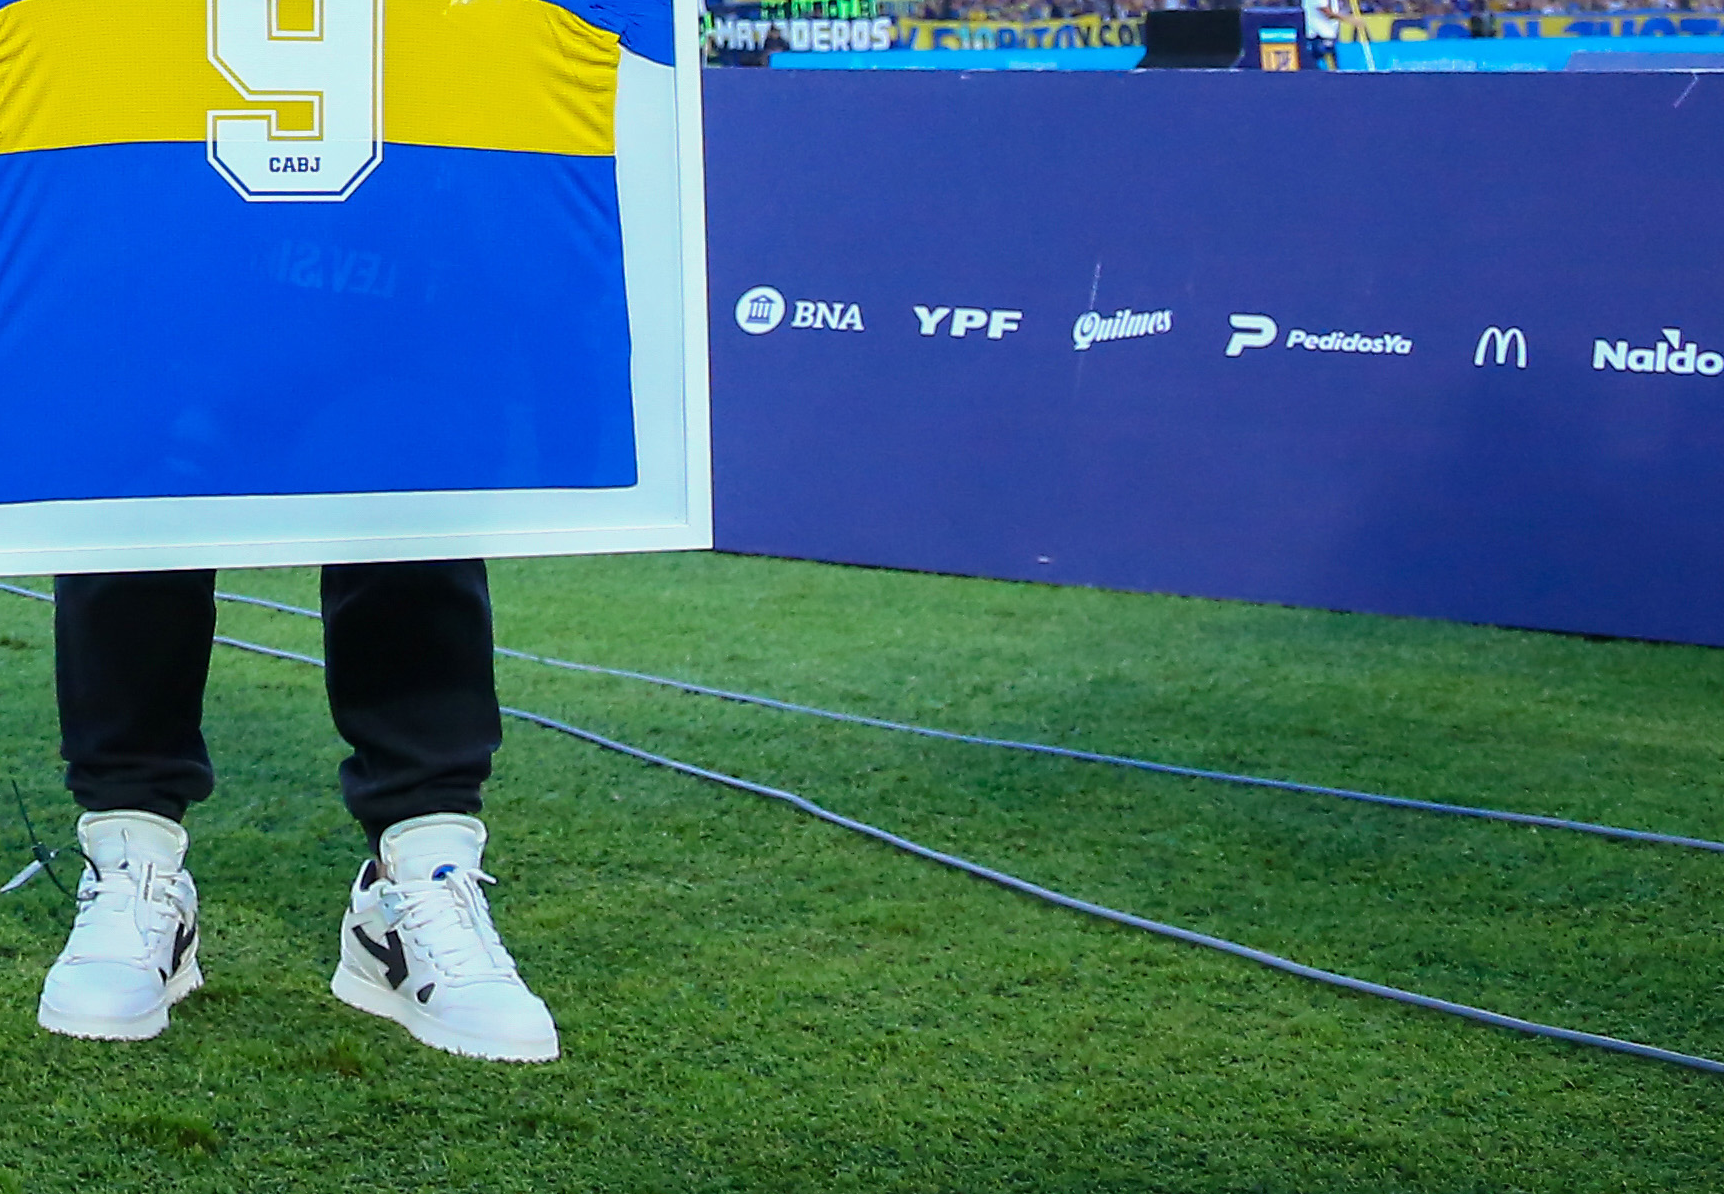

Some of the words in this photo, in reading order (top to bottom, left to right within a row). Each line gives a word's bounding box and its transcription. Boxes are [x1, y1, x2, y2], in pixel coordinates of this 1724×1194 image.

[269, 156, 321, 173] CABJ
[791, 299, 865, 332] BNA
[913, 306, 1023, 340] YPF
[1072, 309, 1173, 350] Quilmes
[1286, 329, 1413, 356] PedidosYa
[1592, 336, 1724, 376] Naldo
